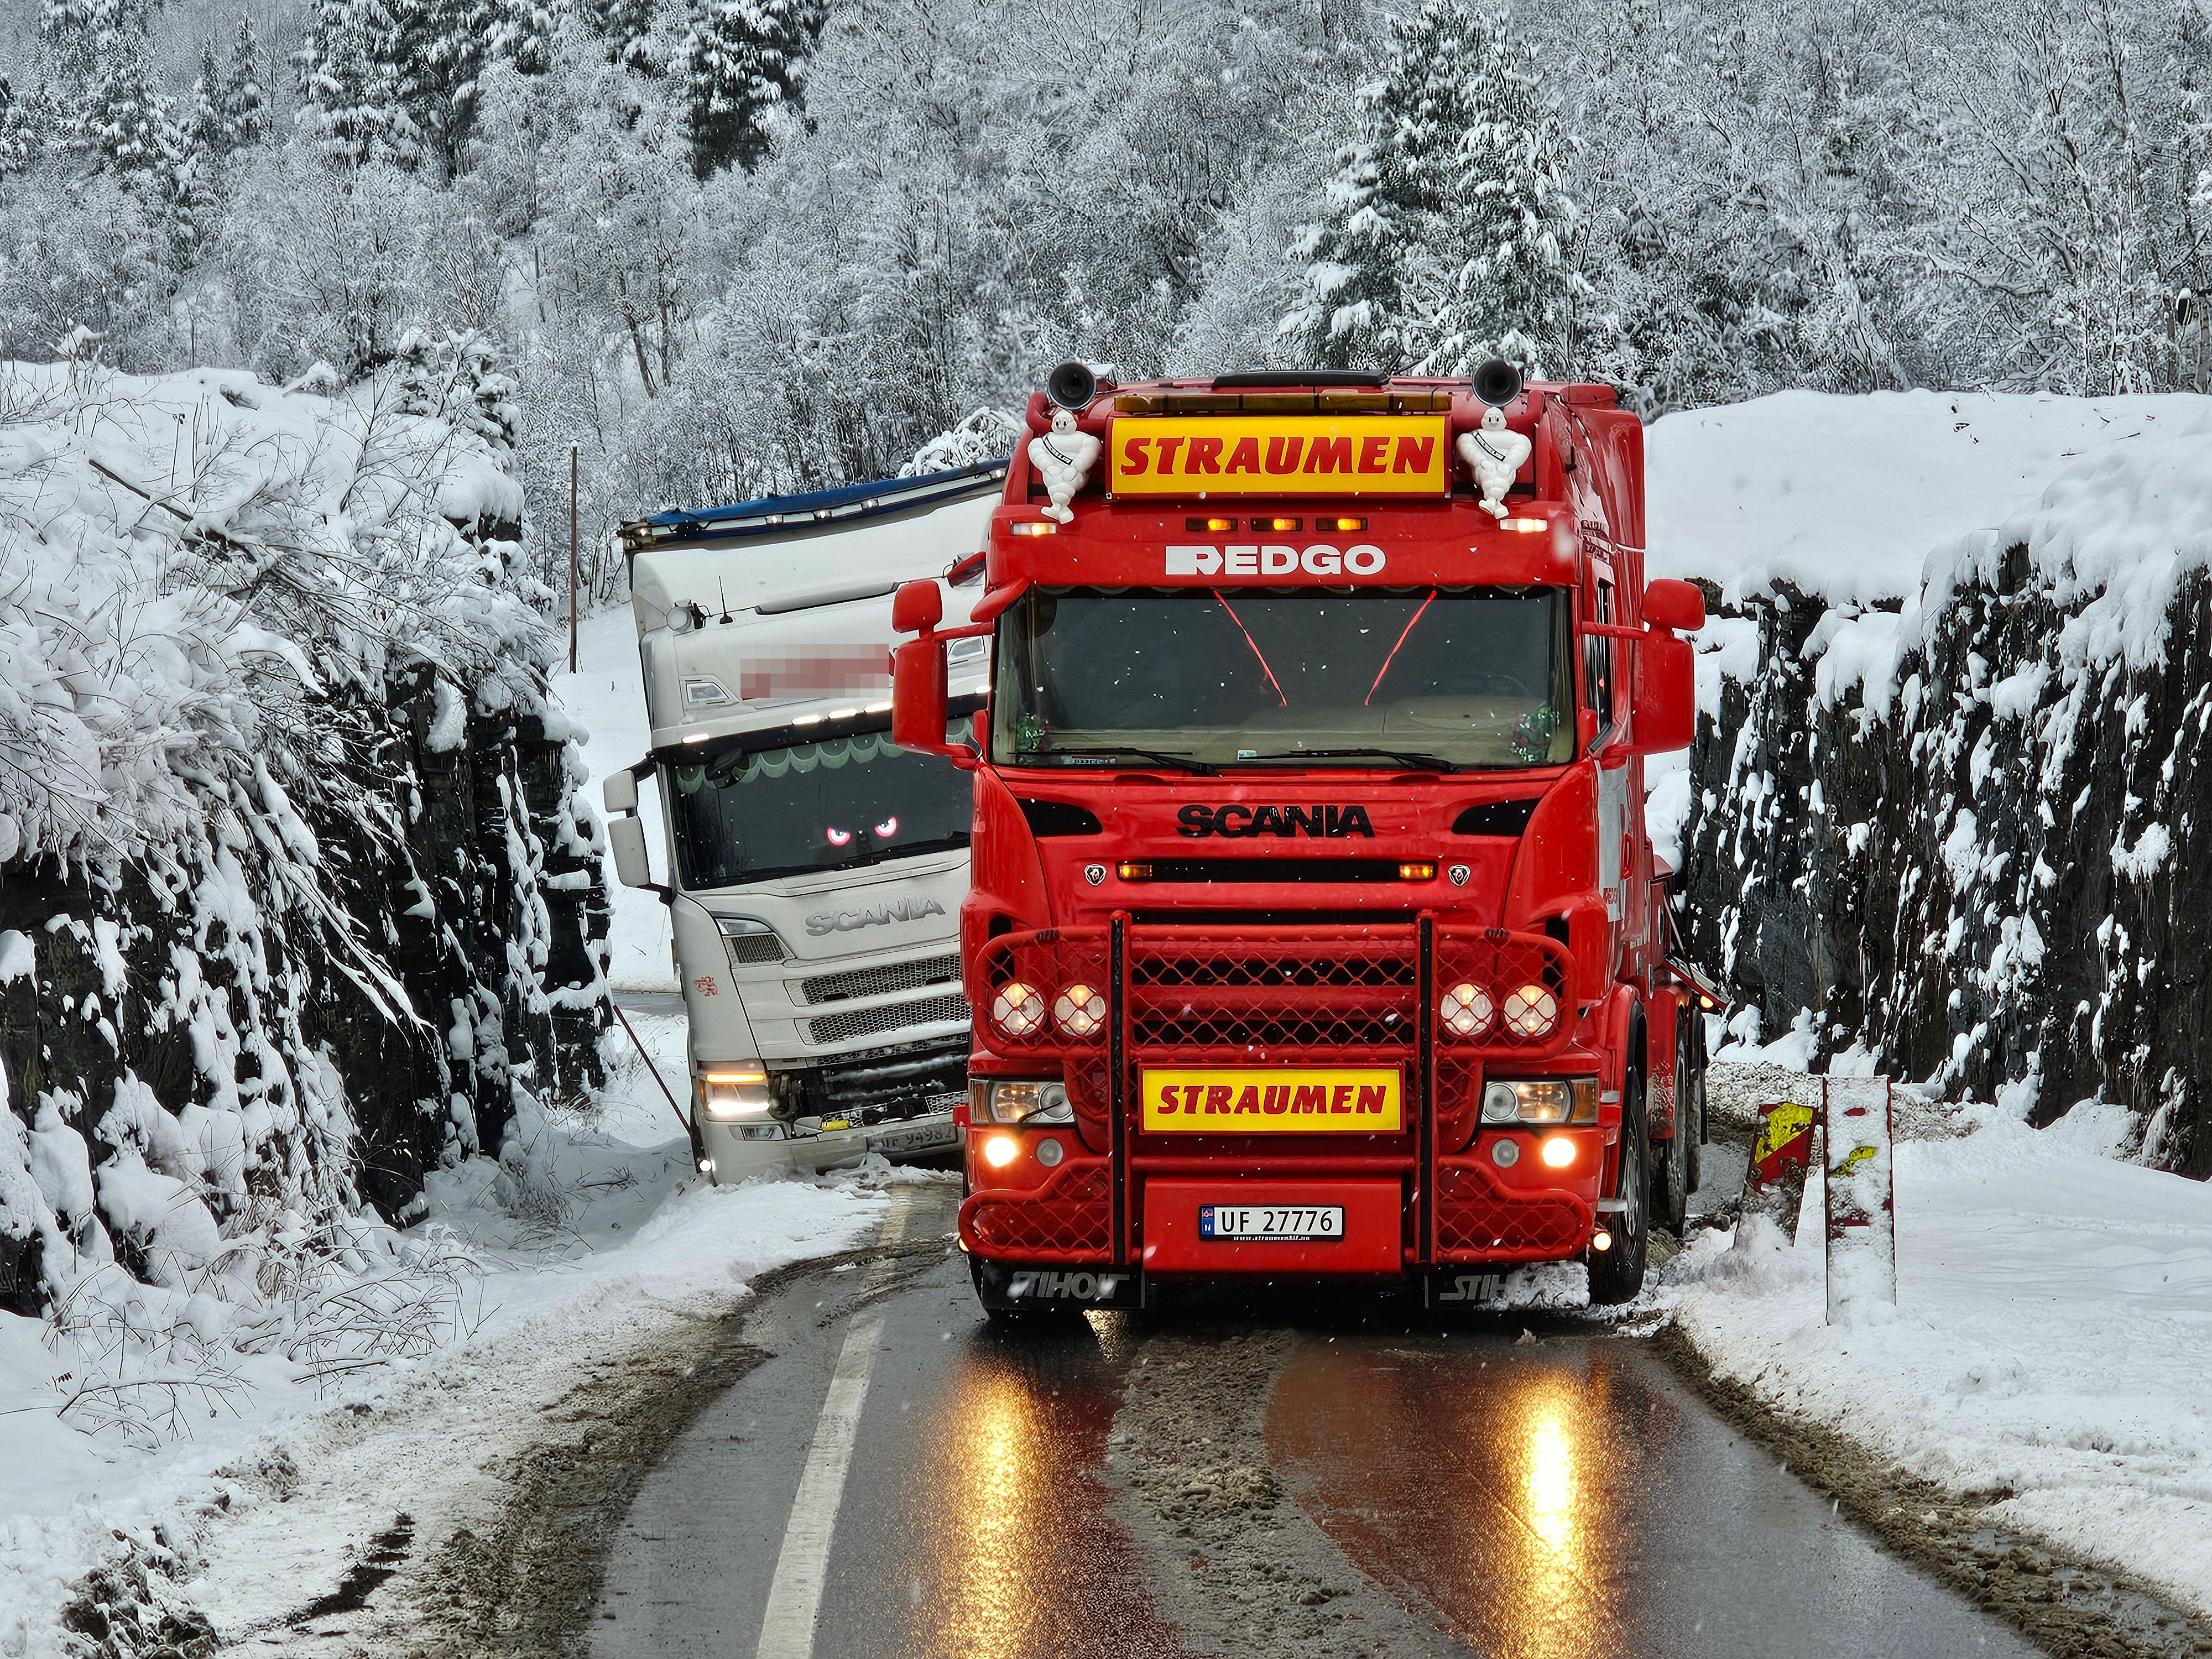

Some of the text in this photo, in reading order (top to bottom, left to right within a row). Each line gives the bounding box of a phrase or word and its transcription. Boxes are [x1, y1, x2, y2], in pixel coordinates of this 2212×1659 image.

[1119, 436, 1434, 474] STRAUMEN
[1165, 544, 1386, 575] REDGO
[1176, 805, 1376, 838] SCANIA
[805, 894, 946, 936] SCANIA
[1157, 1085, 1387, 1114] STRAUMEN
[1222, 1210, 1333, 1233] UF 27776
[1439, 1274, 1507, 1300] STIH
